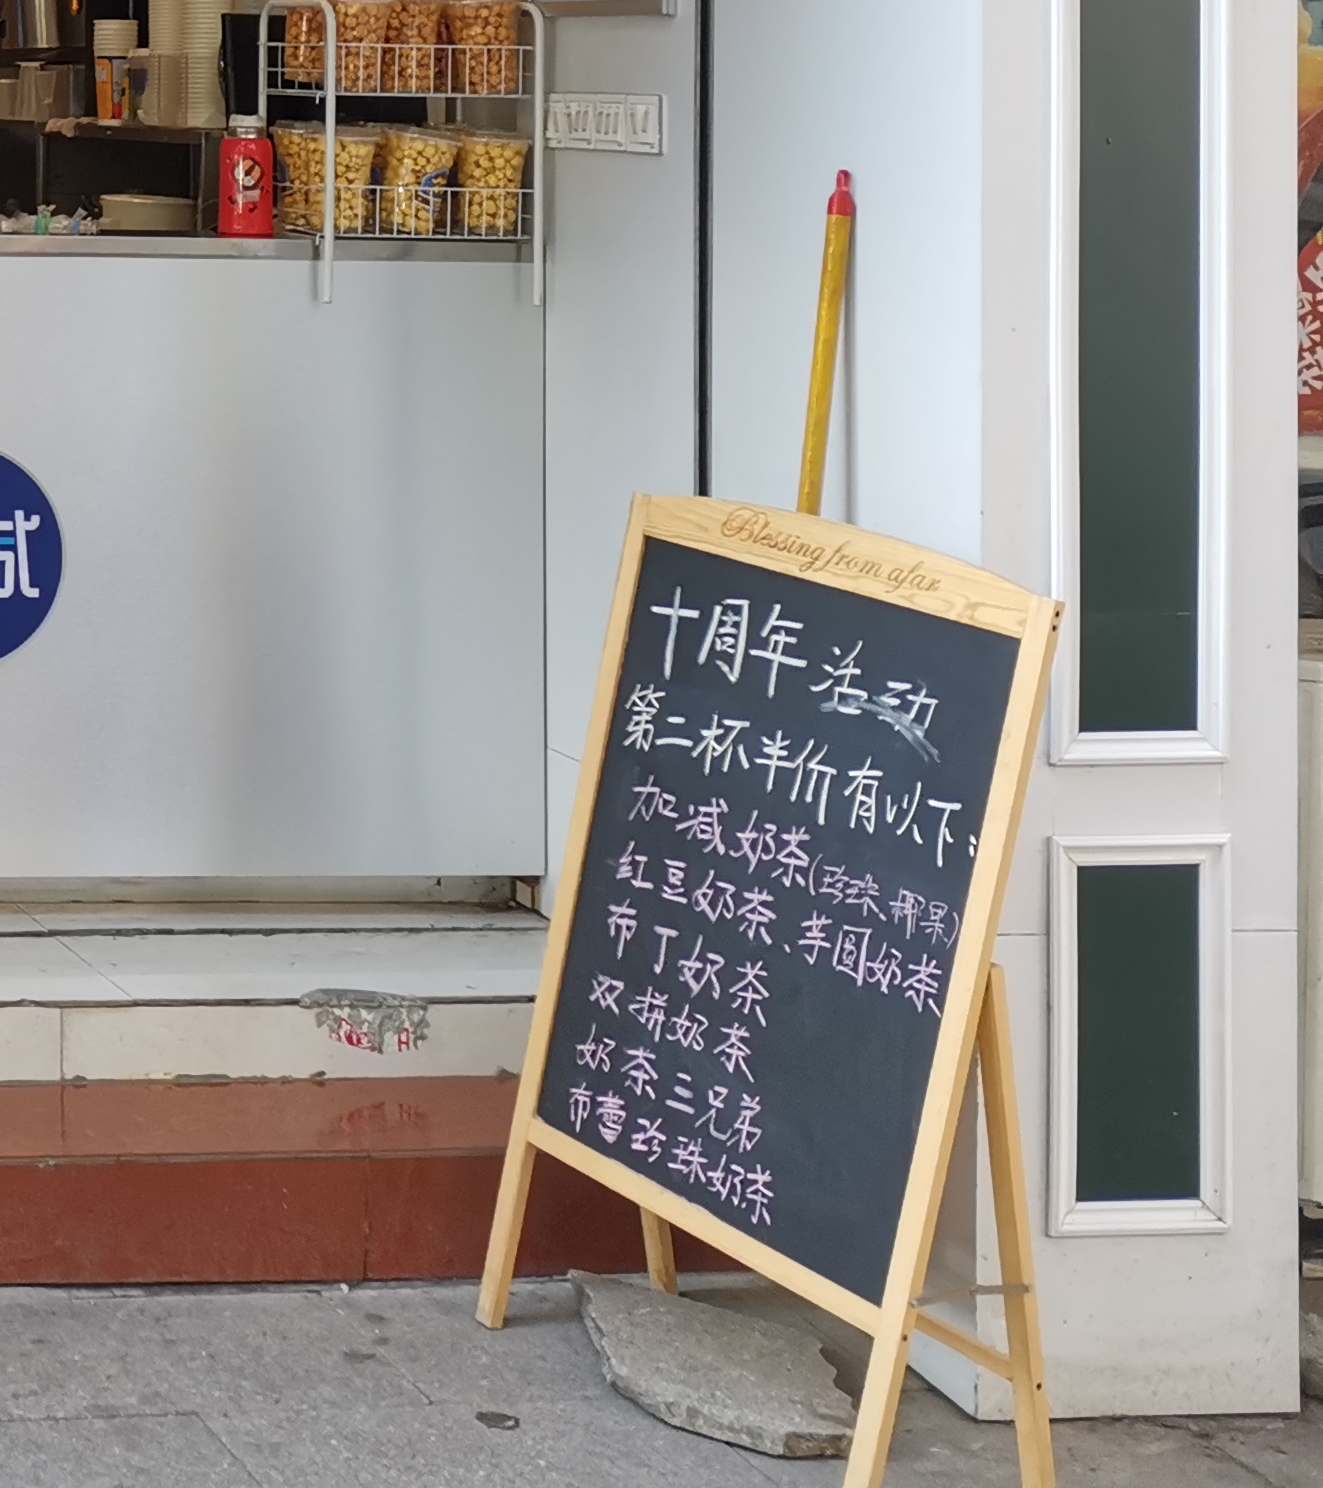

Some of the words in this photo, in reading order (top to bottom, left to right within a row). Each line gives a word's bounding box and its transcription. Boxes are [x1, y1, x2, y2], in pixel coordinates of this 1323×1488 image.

[720, 506, 826, 573] Blessing
[810, 539, 881, 579] from
[649, 585, 940, 732] 十周年活动
[588, 971, 755, 1084] 双拼奶茶
[606, 897, 771, 1028] 布丁奶茶
[575, 1021, 763, 1154] 奶茶三兄弟
